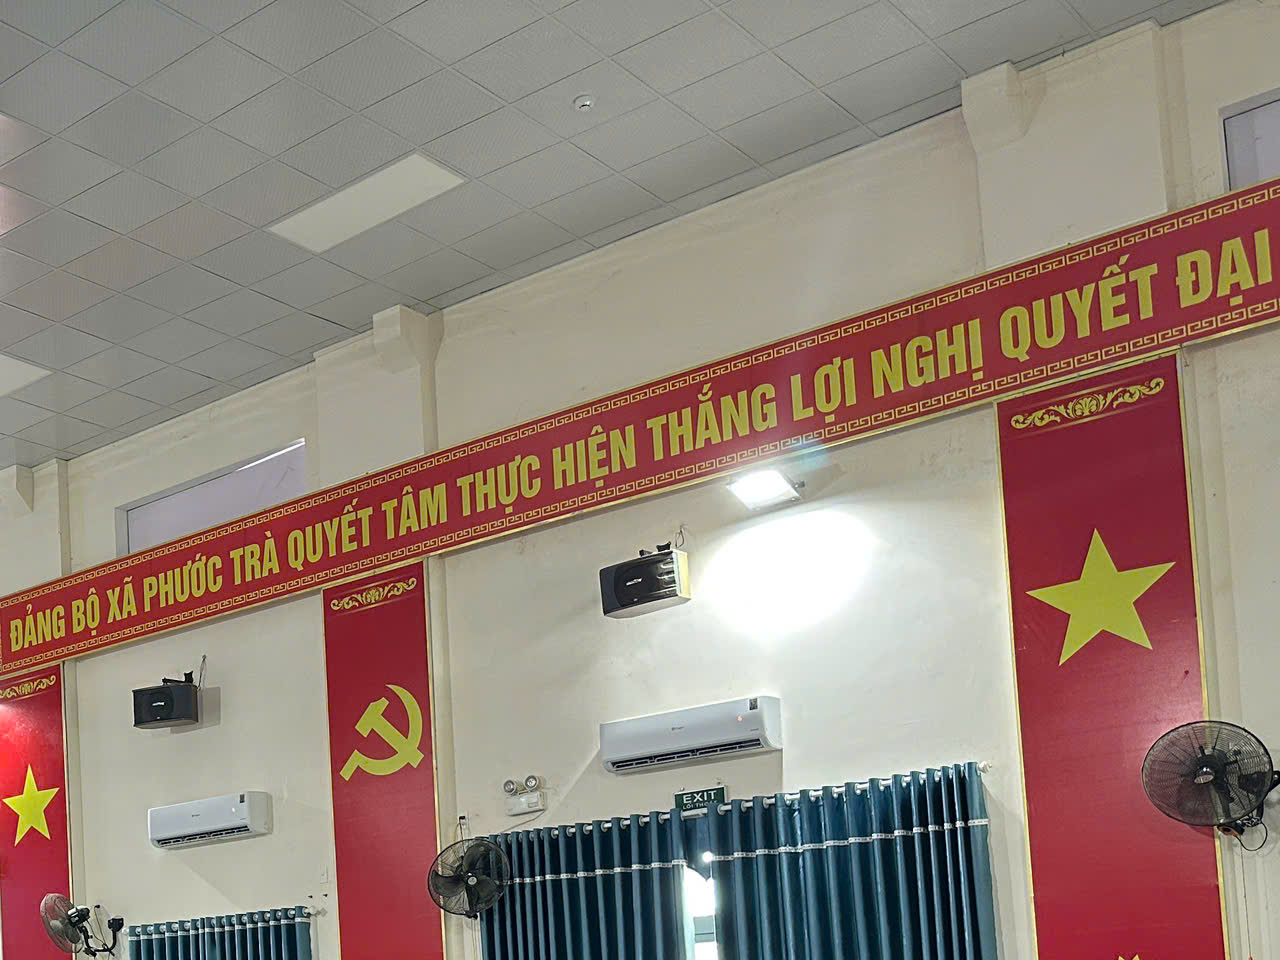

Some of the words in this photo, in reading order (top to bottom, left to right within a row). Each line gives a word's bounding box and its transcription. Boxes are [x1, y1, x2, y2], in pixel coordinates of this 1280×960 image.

[10, 602, 65, 652] ĐẢNG
[72, 590, 100, 631] BỘ
[107, 578, 137, 623] XÃ
[143, 553, 223, 612] PHƯỚC
[230, 531, 280, 585] TRÀ
[287, 499, 373, 571] QUYẾT
[381, 482, 448, 539] TÂM
[457, 453, 541, 516] THỰC
[552, 427, 636, 490] HIỆN
[647, 383, 778, 462] THẮNG
[790, 356, 857, 424] LỢI
[871, 318, 985, 400] NGHỊ
[998, 253, 1158, 362] QUYẾT
[1175, 228, 1273, 308] ĐẠI
[683, 790, 717, 804] EXIT
